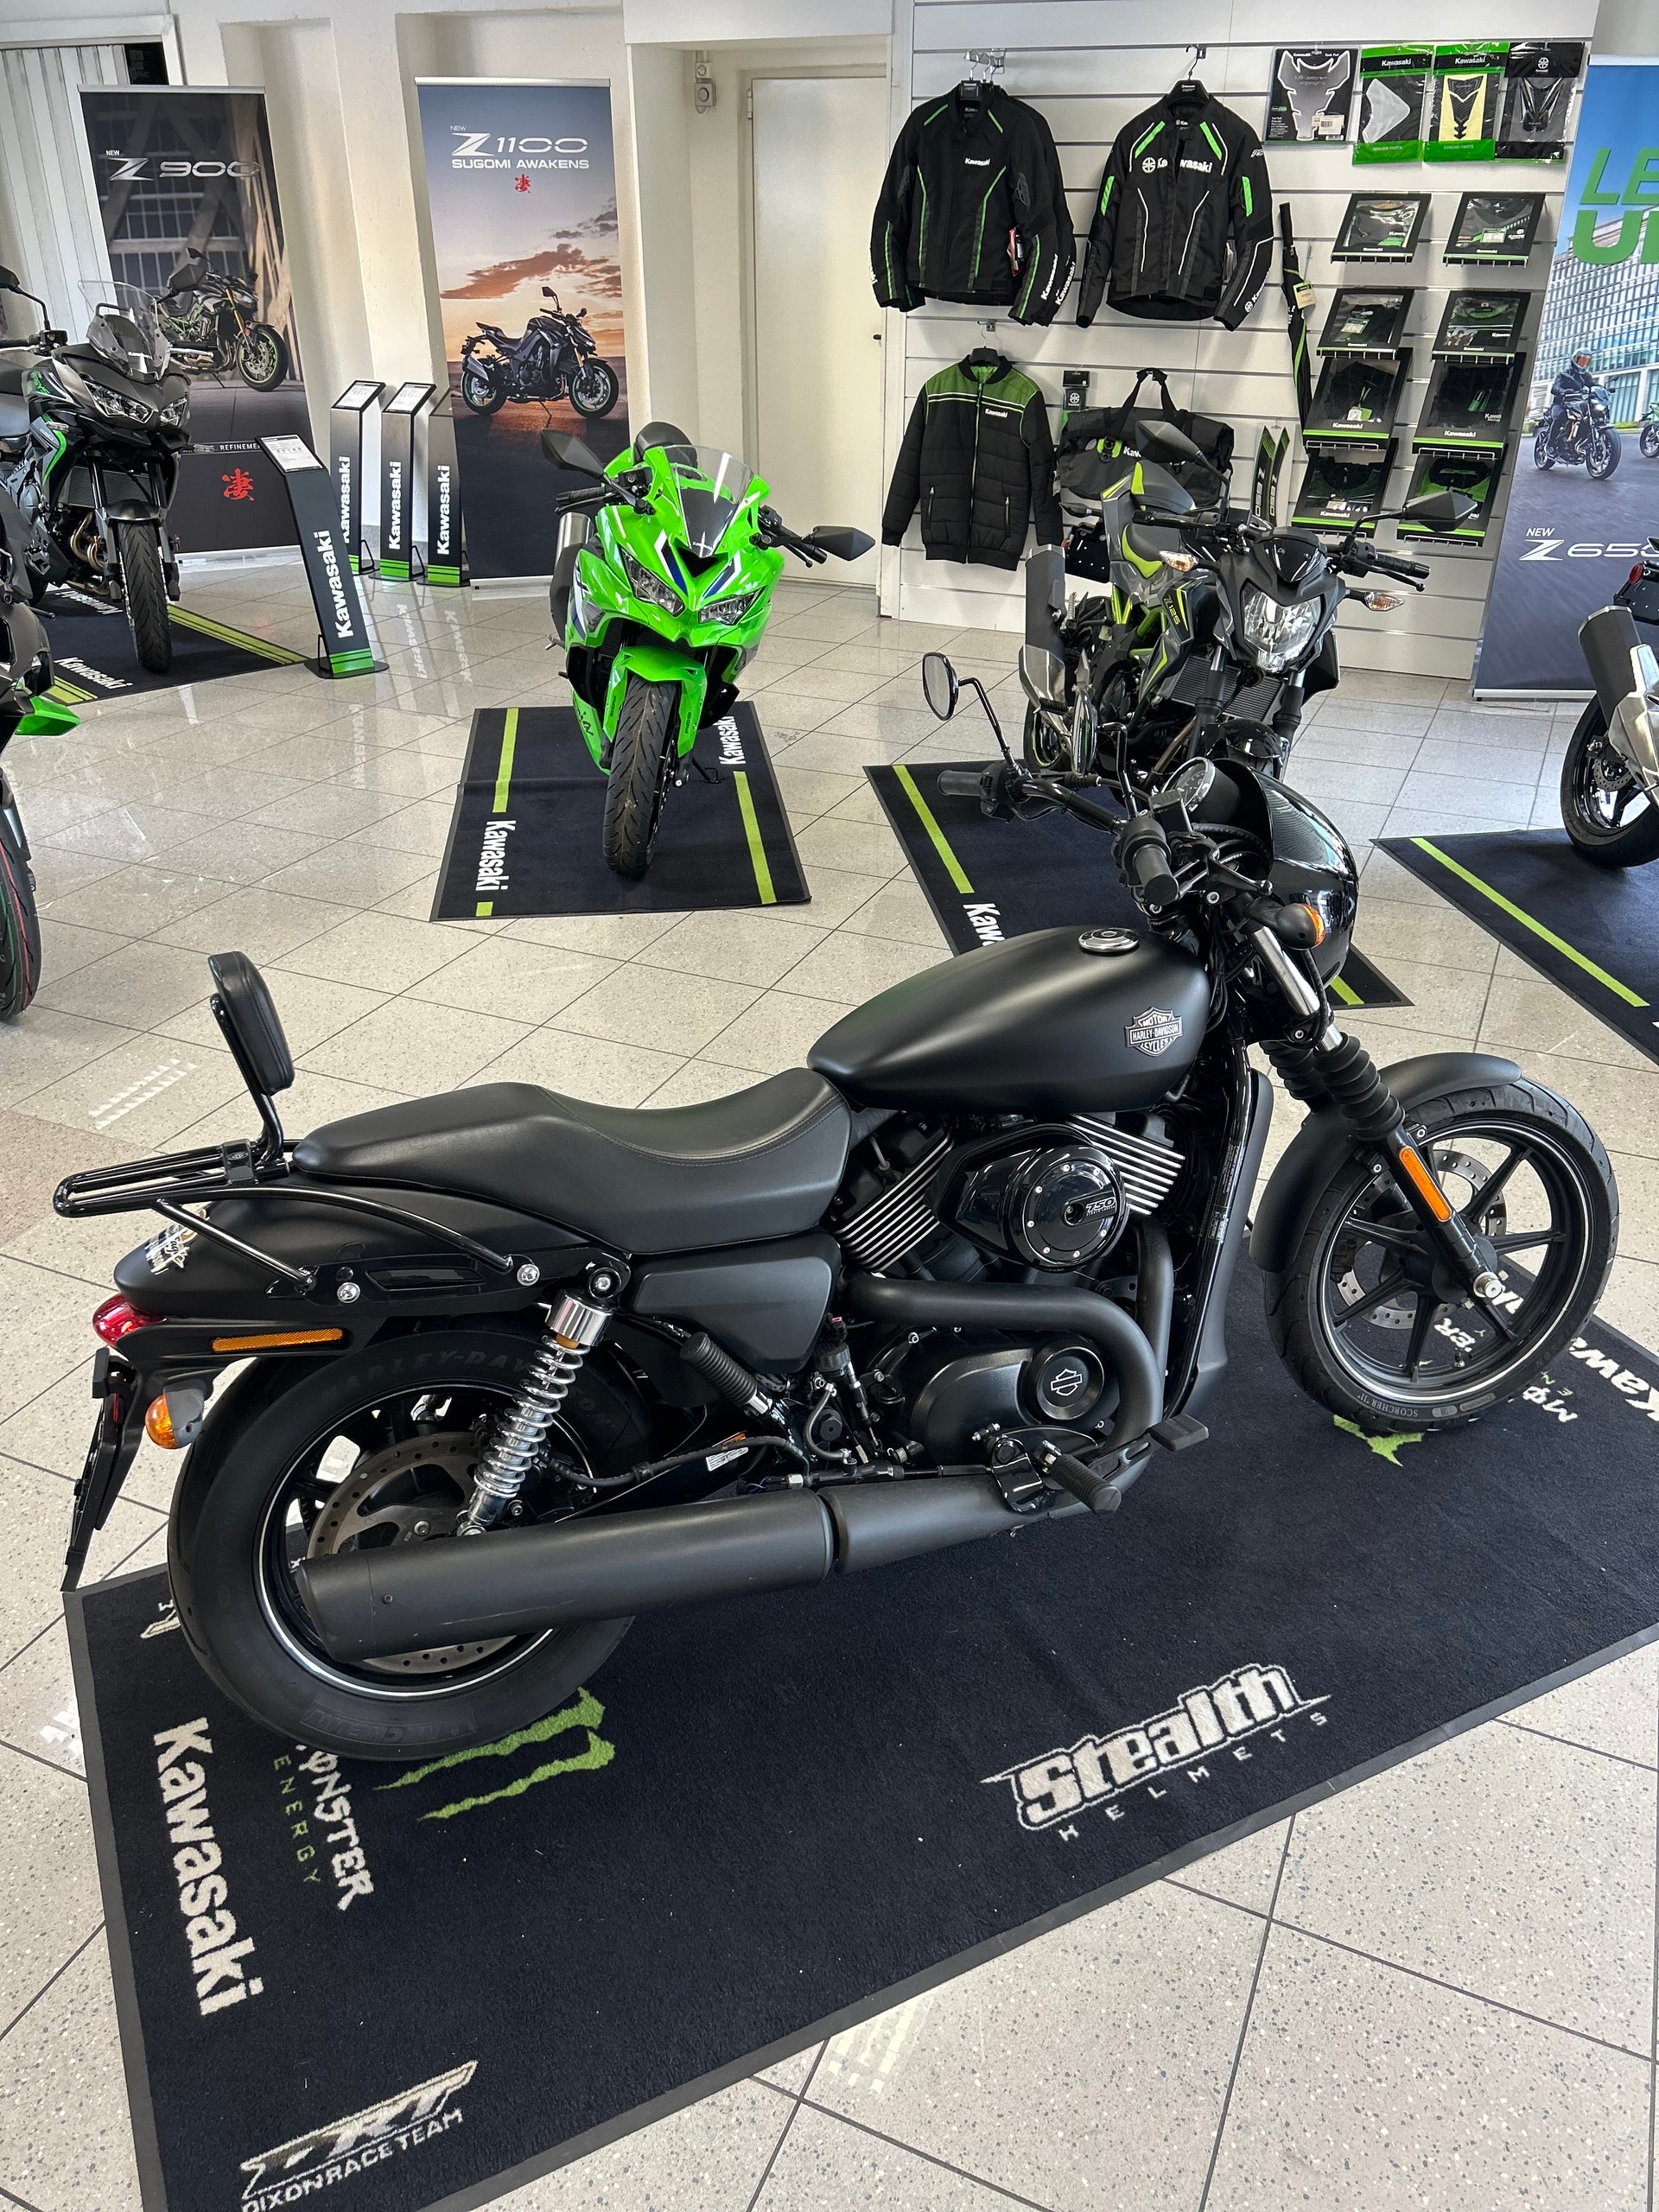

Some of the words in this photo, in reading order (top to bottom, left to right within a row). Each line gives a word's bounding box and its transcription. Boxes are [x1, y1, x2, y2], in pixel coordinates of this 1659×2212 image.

[1381, 58, 1412, 67] Kawasaki
[451, 159, 511, 169] SUGOMI
[516, 159, 589, 169] AWAKENS
[1055, 261, 1076, 306] Kawasaki
[985, 408, 1007, 418] Kawasaki
[388, 461, 402, 550] Kawasaki
[436, 465, 450, 556] Kawasaki
[1525, 527, 1555, 537] NEW
[313, 530, 355, 639] Kawasaki
[54, 657, 134, 690] Kawasaki
[475, 819, 517, 892] Kawasaki
[1131, 1022, 1179, 1042] HARLEY-DAVIDSON
[1141, 1014, 1171, 1027] MOTOR
[1143, 1037, 1170, 1052] CYCLES
[1085, 1196, 1116, 1213] 750
[1371, 1399, 1419, 1418] SCORCHER
[1017, 1666, 1299, 1827] Stealth
[1058, 1711, 1328, 1841] HELMETS
[272, 1755, 322, 1885] ENERGY
[153, 1717, 264, 2017] Kawasaki
[325, 2145, 395, 2187] RACE
[395, 2107, 464, 2152] TEAM
